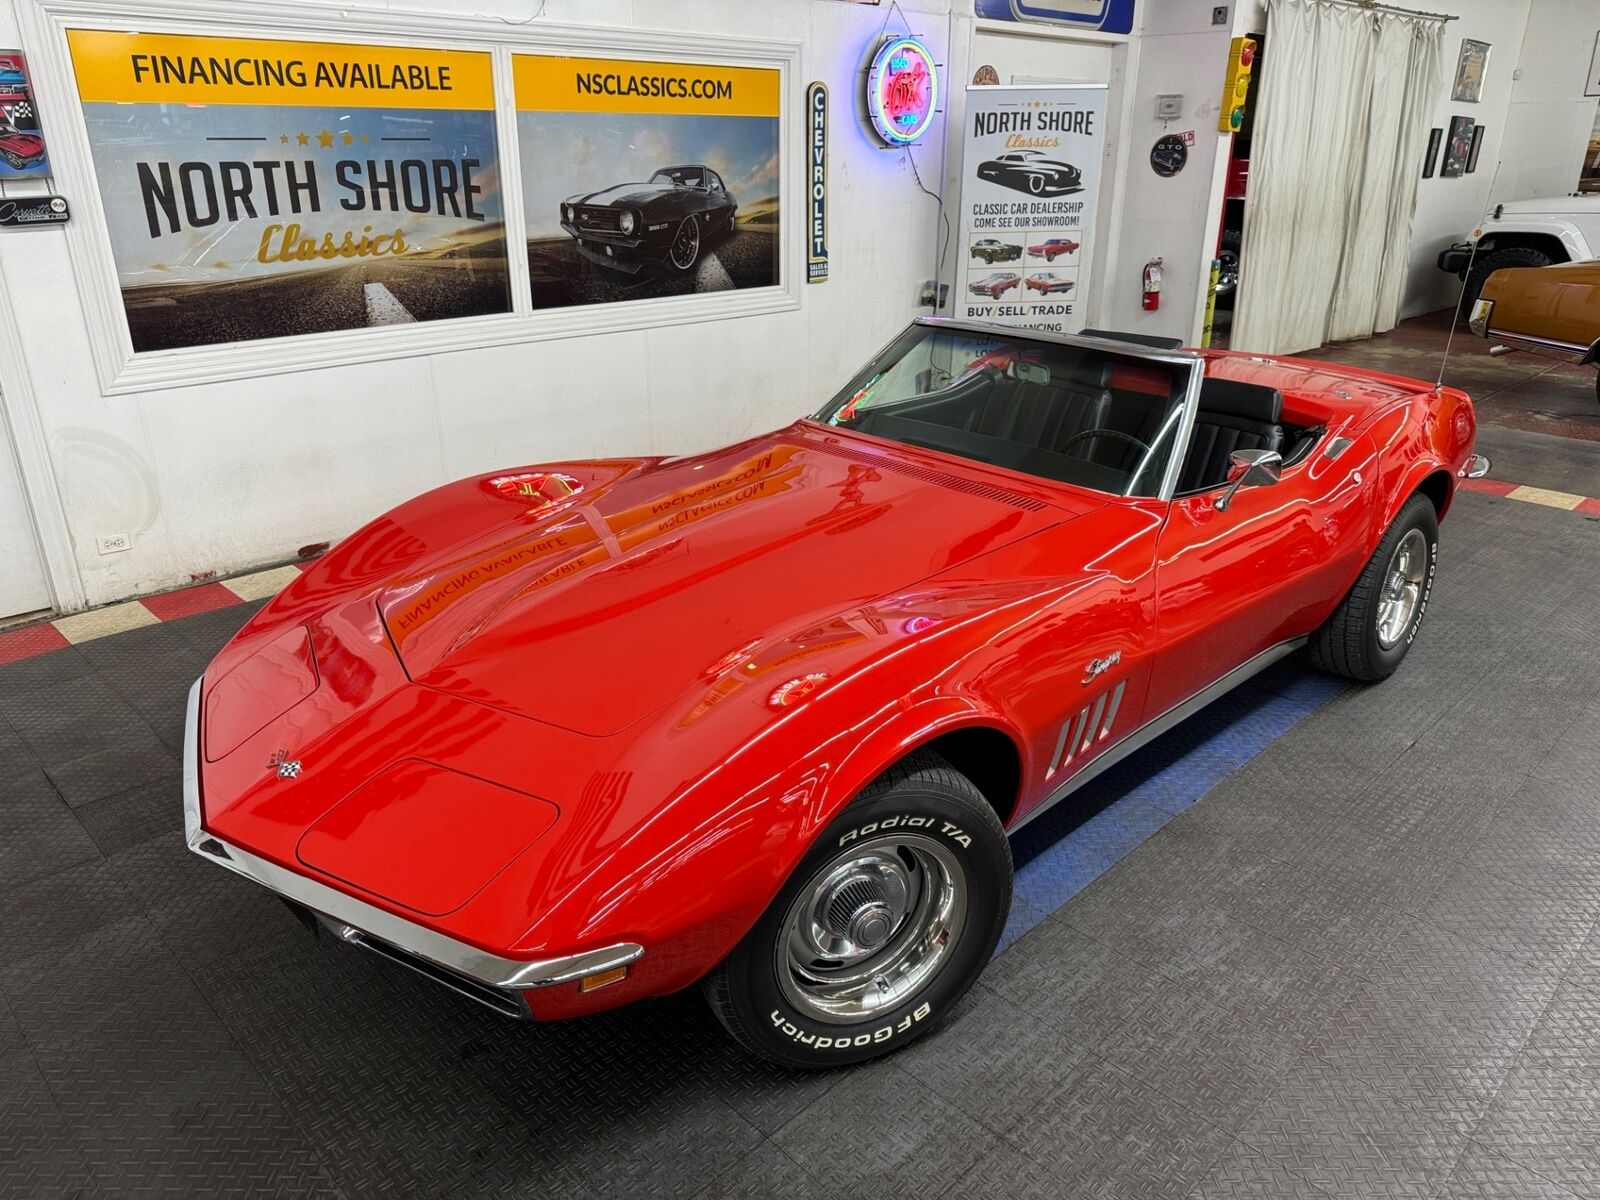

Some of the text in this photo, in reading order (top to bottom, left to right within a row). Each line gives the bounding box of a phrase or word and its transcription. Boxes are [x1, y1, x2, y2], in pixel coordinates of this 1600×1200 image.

[132, 54, 453, 91] FINANCING AVAILABLE
[576, 72, 733, 100] NSCLASSICS.COM
[974, 110, 1095, 138] NORTH SHORE
[1004, 134, 1061, 149] Classics
[813, 92, 825, 254] CHEVROLET
[0, 202, 51, 221] Corvette
[135, 157, 486, 239] NORTH SHORE
[973, 202, 1084, 216] CLASSIC CAR DEALERSHIP
[974, 216, 1080, 229] COME SEE OUR SHOWROOM!
[257, 223, 410, 265] Classics
[838, 815, 973, 849] Radial T/A
